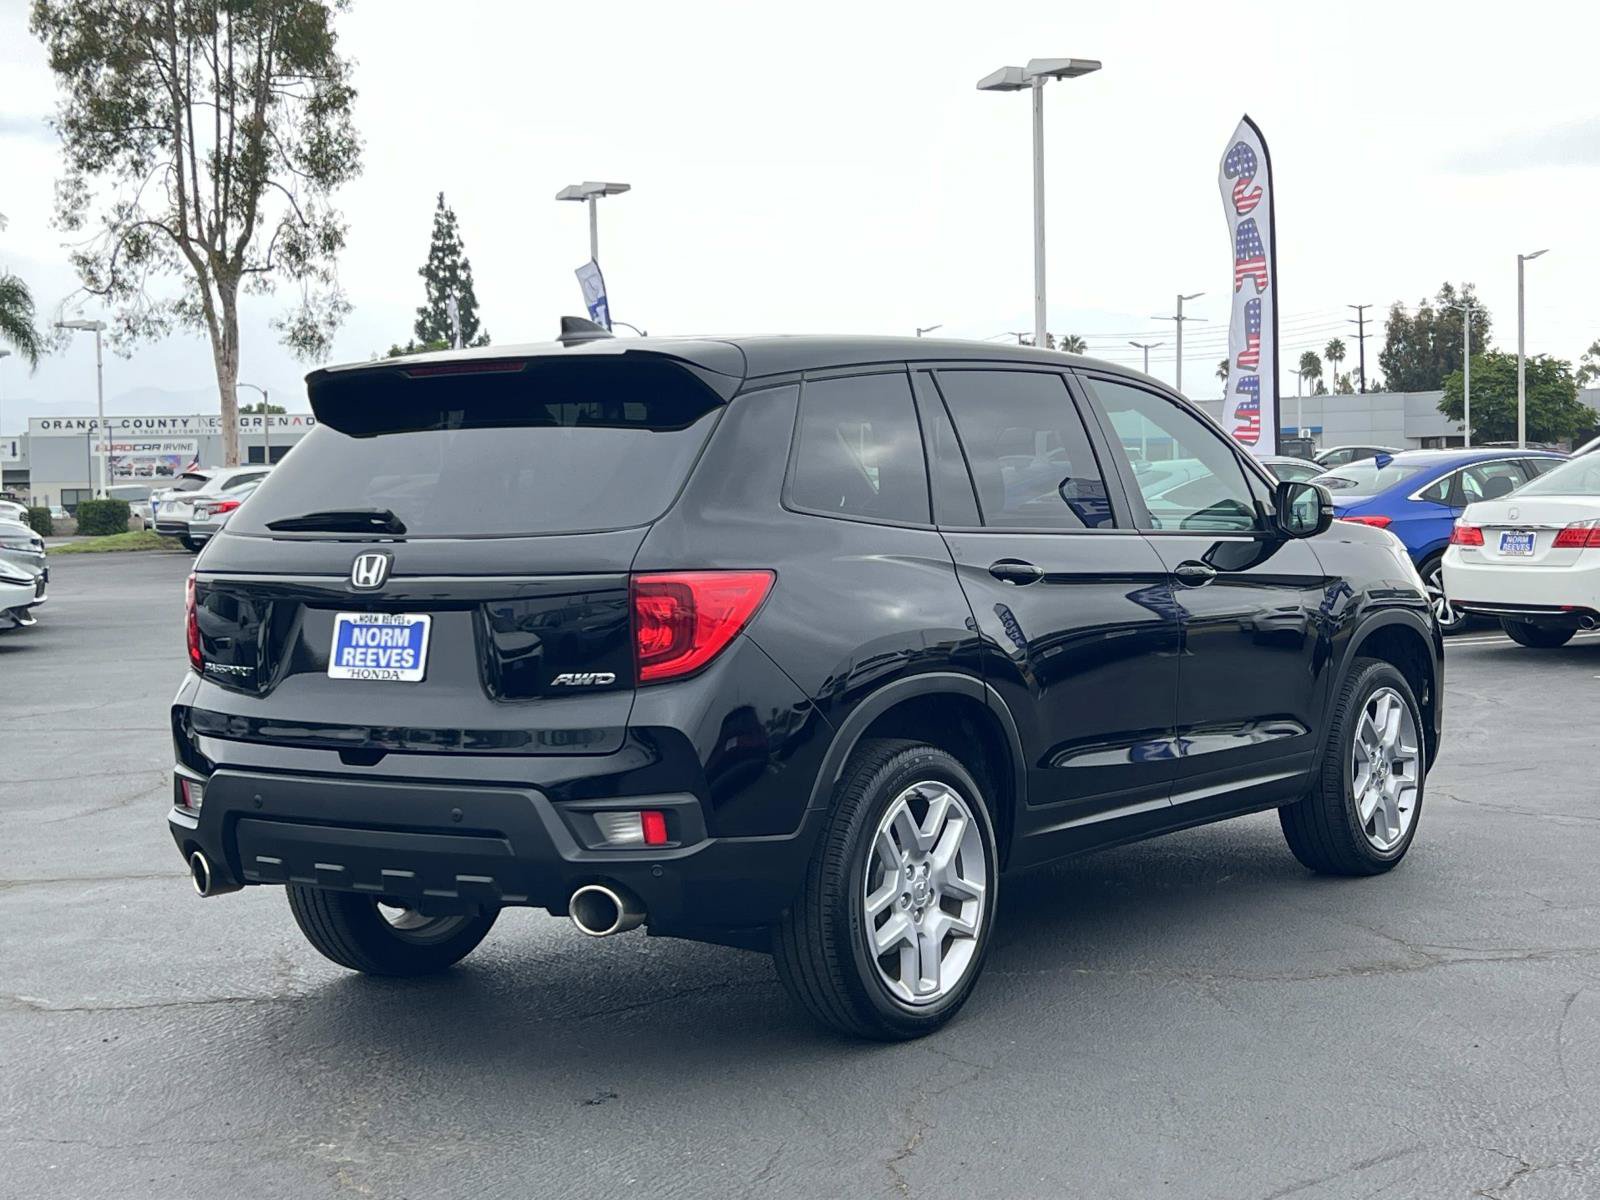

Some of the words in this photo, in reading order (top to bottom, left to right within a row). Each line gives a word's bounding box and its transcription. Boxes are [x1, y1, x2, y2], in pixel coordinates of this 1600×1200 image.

[41, 420, 109, 430] ORANGE
[121, 419, 190, 429] COUNTY
[163, 442, 193, 451] IRVINE
[1506, 534, 1529, 544] NORM
[1503, 543, 1531, 551] REEVES
[351, 628, 411, 647] NORM
[341, 648, 416, 668] REEVES
[550, 672, 616, 686] AWD
